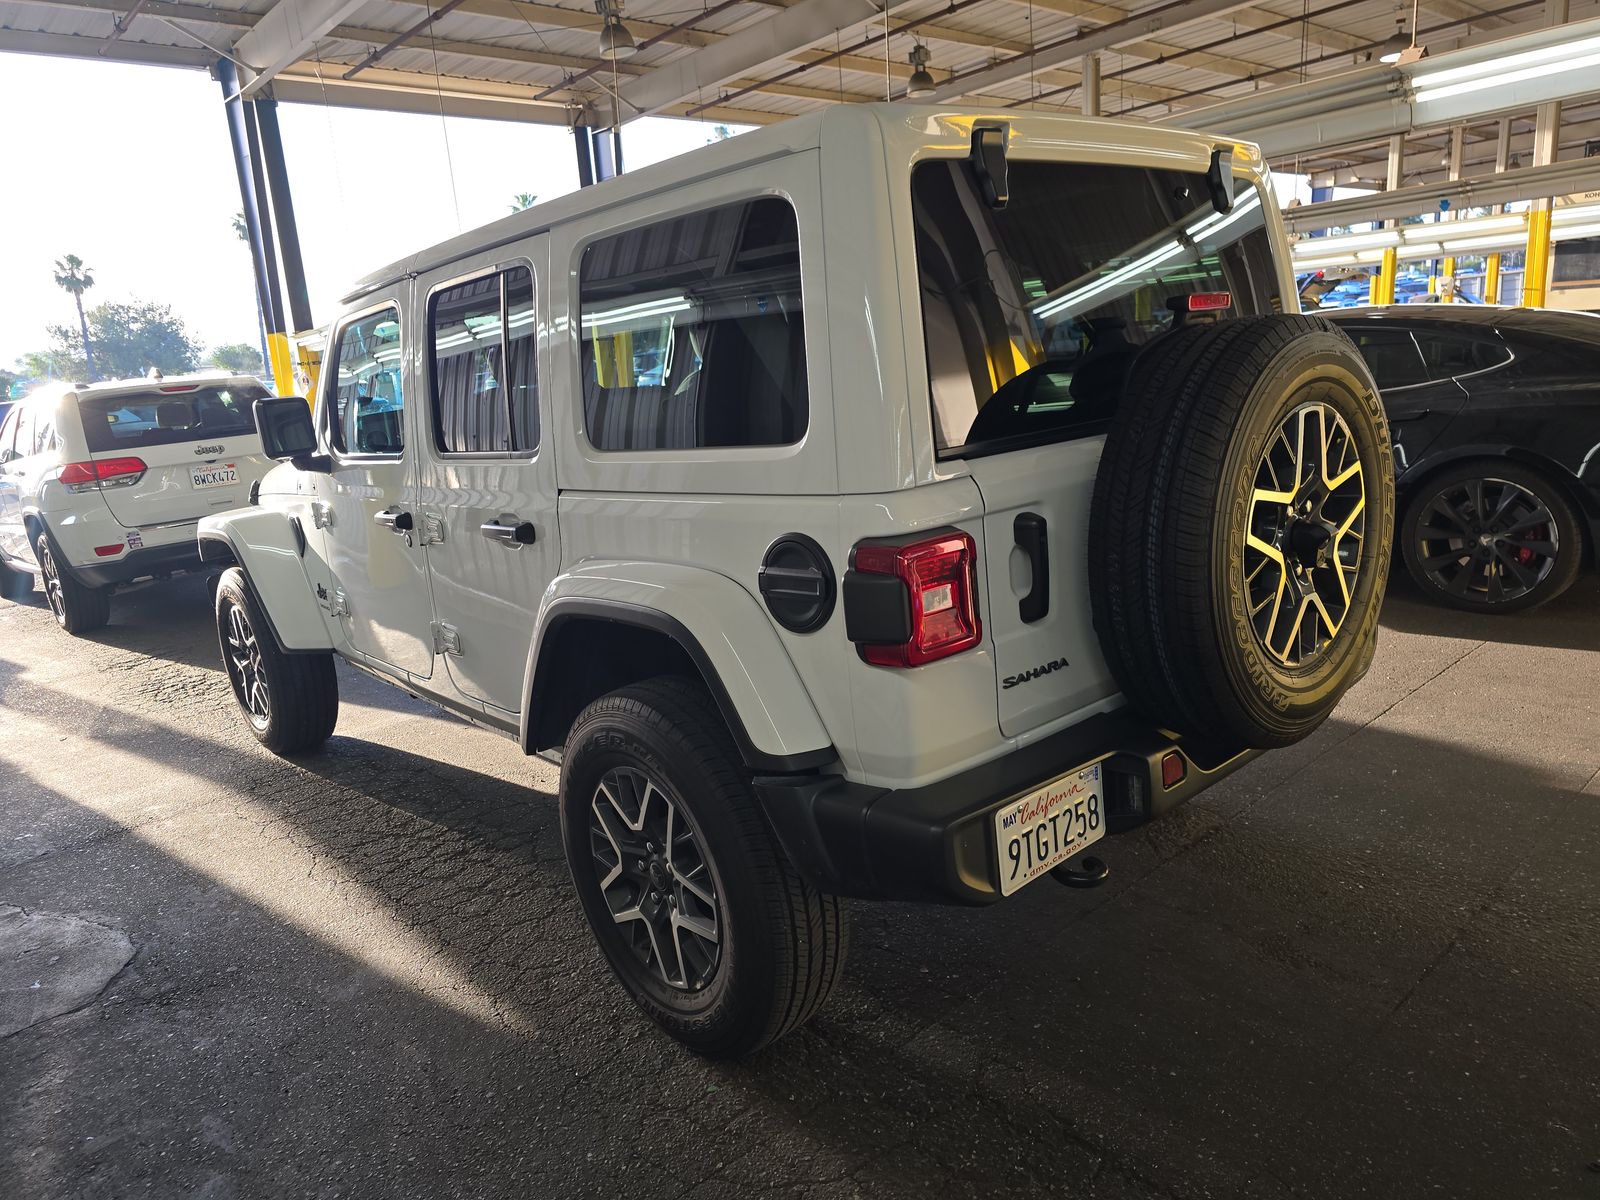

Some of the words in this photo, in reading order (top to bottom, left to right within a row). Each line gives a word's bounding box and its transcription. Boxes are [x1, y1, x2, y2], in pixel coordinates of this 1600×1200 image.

[194, 445, 225, 455] Jeep
[193, 470, 237, 486] 8WCK472
[1229, 434, 1289, 711] BRIDGESTONE
[1002, 657, 1069, 690] SAHARA
[1002, 811, 1017, 830] MAY
[1018, 782, 1085, 825] California
[1008, 793, 1099, 881] 9TGT258
[1029, 840, 1083, 877] dmv.ca.gov
